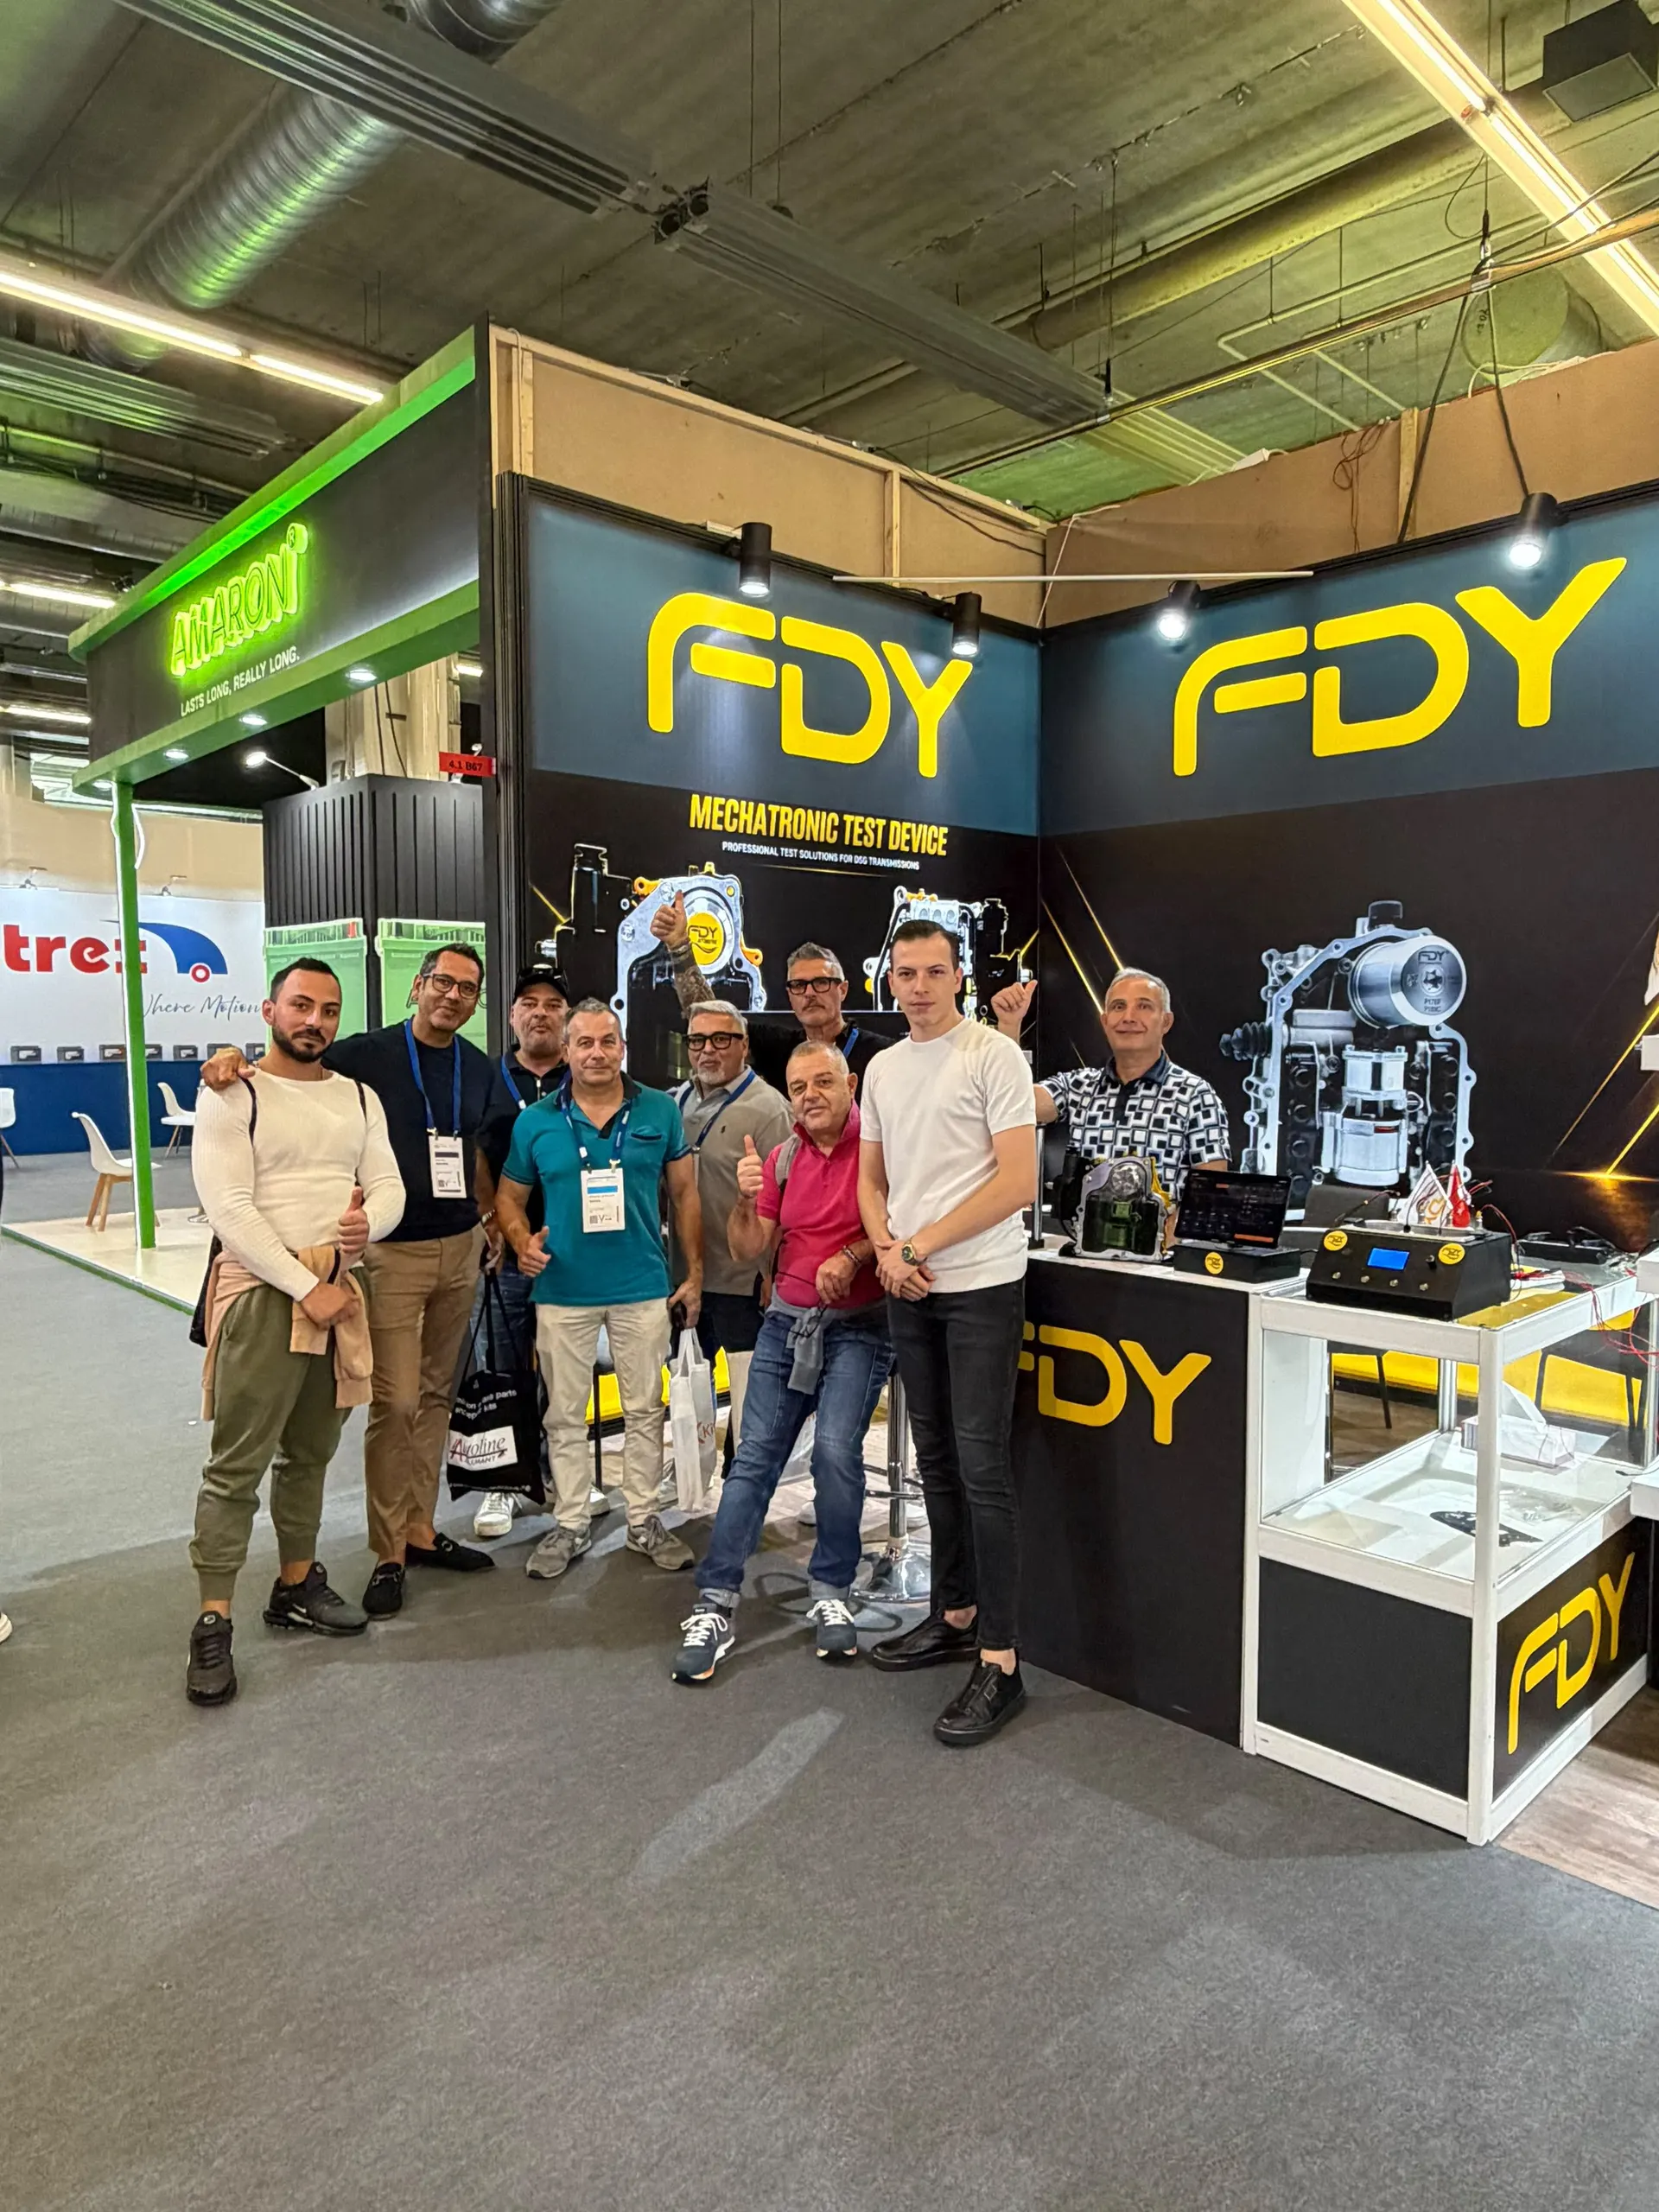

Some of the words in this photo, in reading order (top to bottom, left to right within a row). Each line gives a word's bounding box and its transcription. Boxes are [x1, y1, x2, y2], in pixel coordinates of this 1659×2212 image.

[181, 696, 205, 717] LASTS
[206, 682, 232, 704] LONG,
[233, 660, 267, 692] REALLY
[269, 645, 300, 672] LONG.
[647, 592, 973, 778] FDY
[1173, 557, 1627, 777] FDY
[690, 793, 839, 844] MECHATRONIC
[843, 814, 886, 849] TEST
[888, 820, 948, 855] DEVICE
[721, 841, 779, 856] PROFESSIONAL
[780, 847, 798, 858] TEST
[799, 849, 838, 862] SOLUTIONS
[839, 854, 853, 863] FOR
[868, 856, 920, 871] TRANSMISSIONS
[688, 925, 718, 939] FDY
[1018, 1319, 1211, 1446] DY
[1507, 1552, 1636, 1756] FDY
